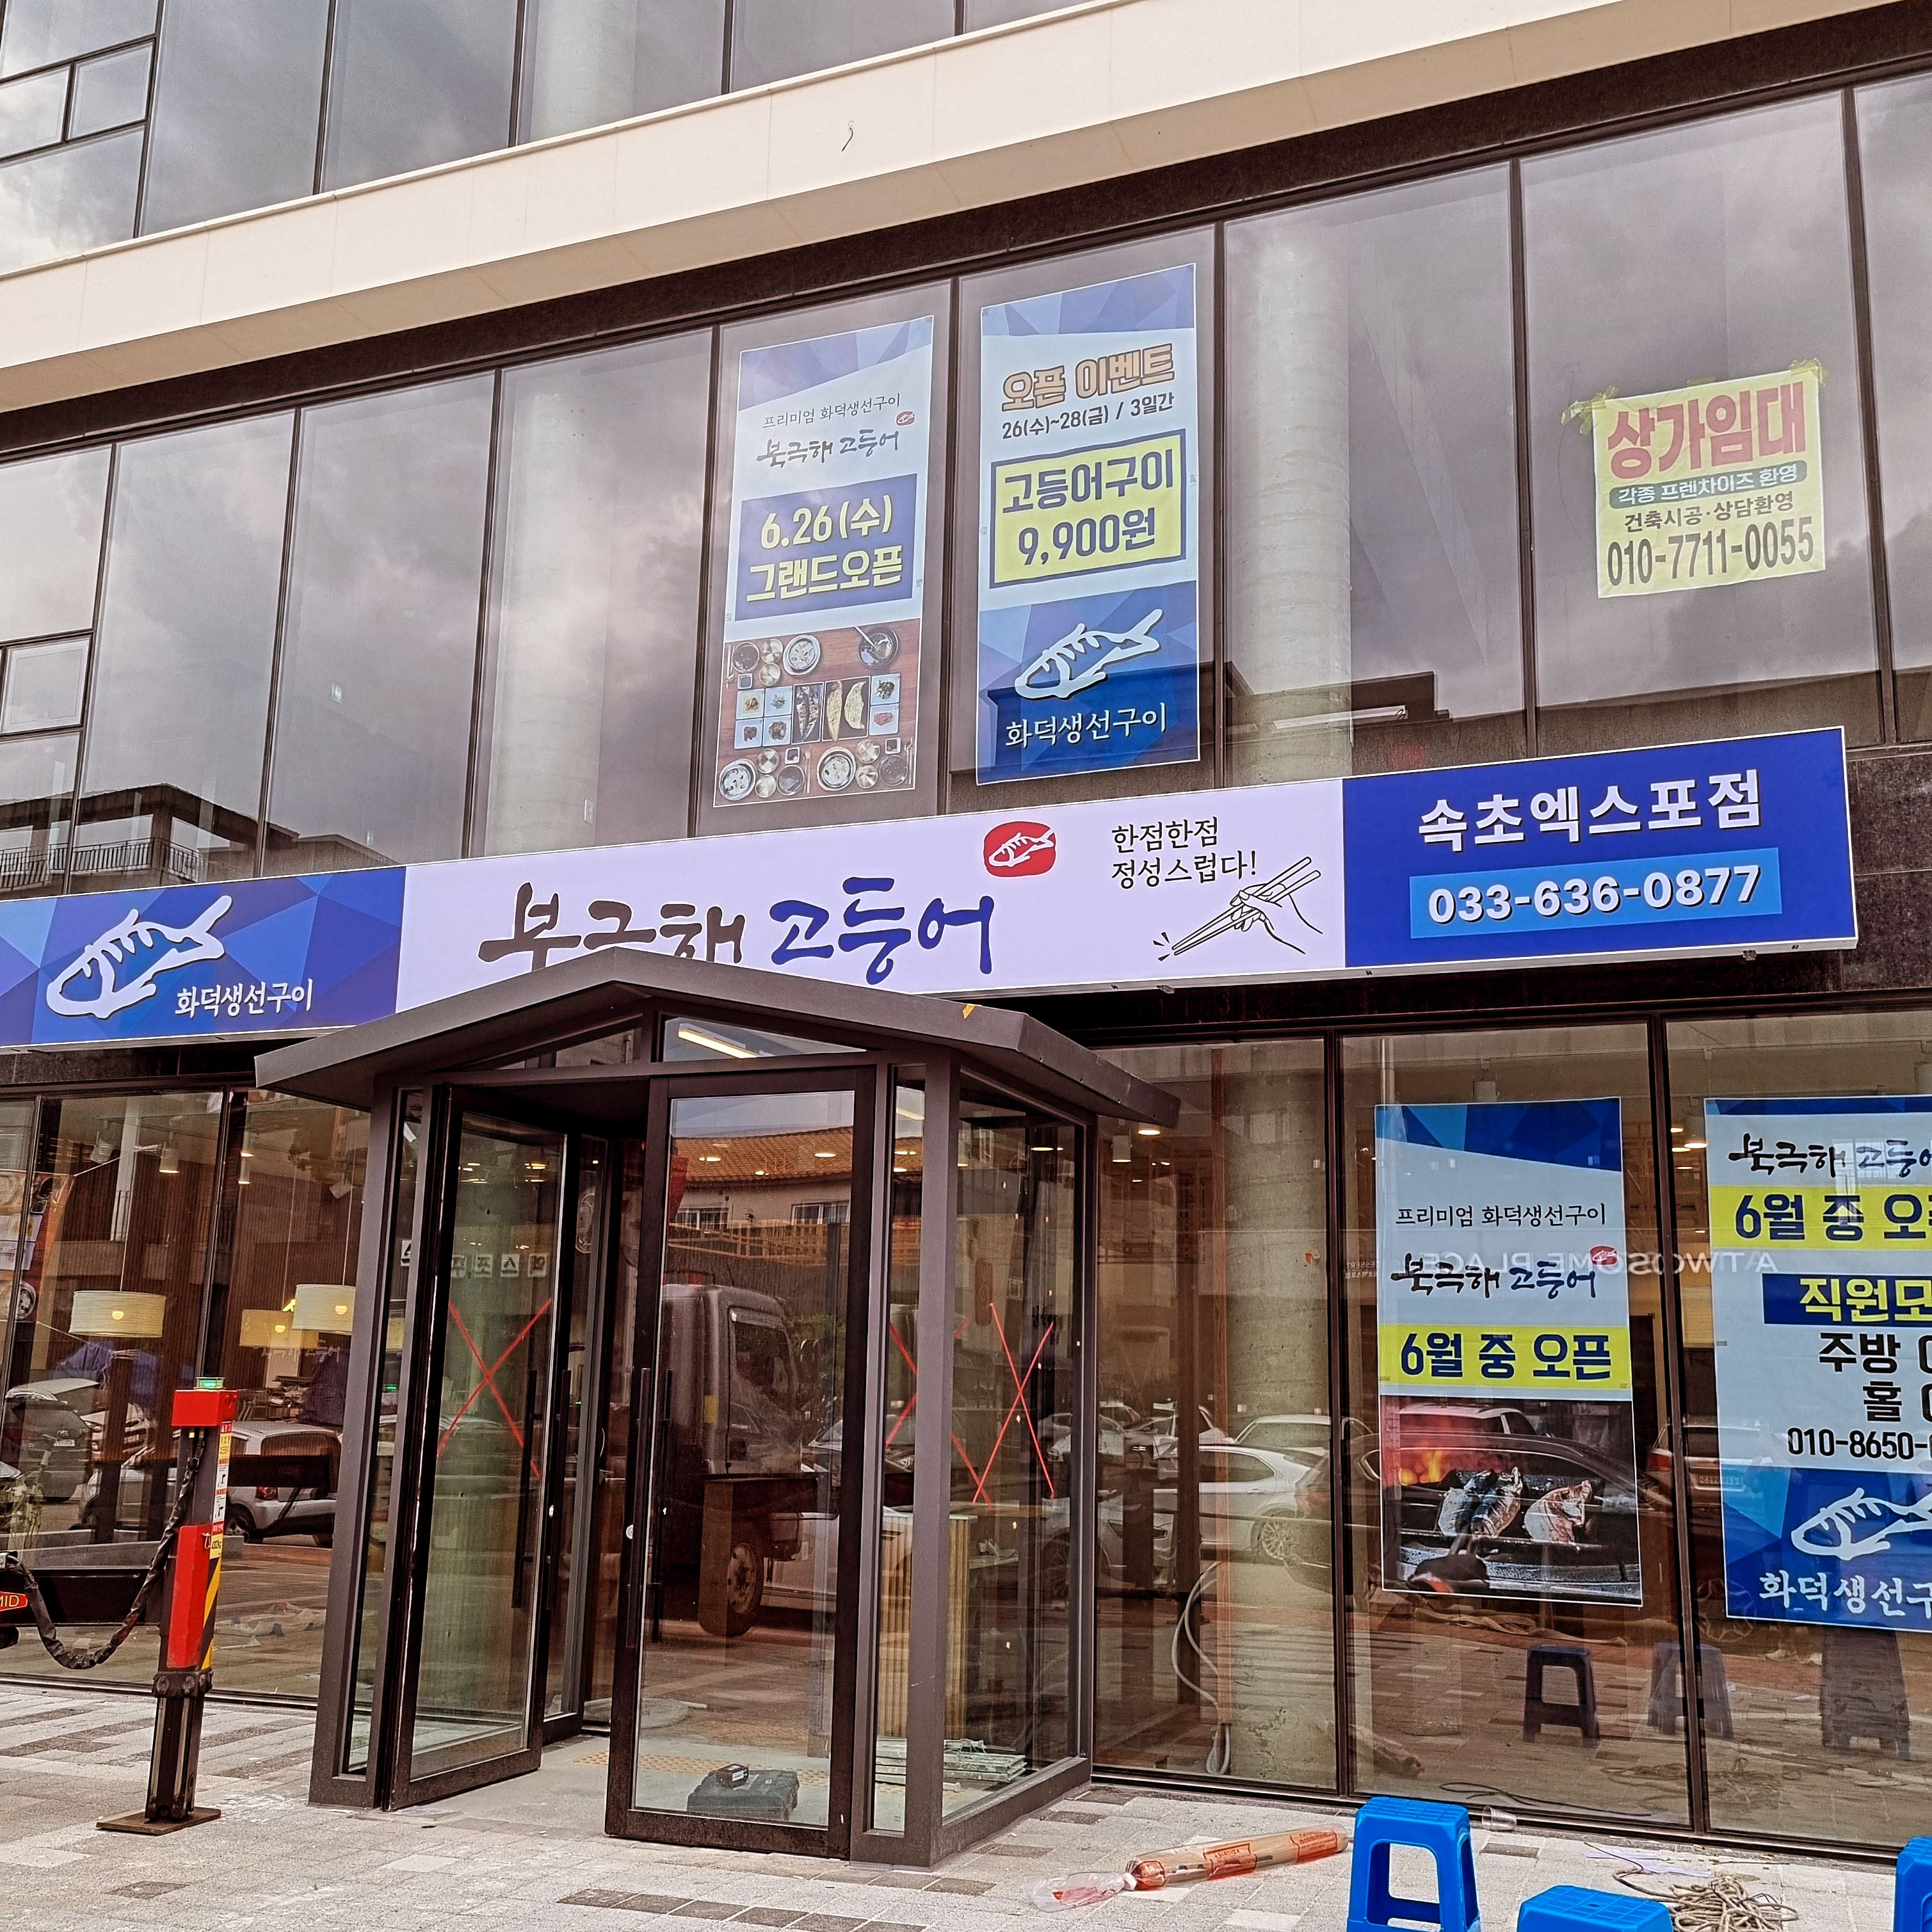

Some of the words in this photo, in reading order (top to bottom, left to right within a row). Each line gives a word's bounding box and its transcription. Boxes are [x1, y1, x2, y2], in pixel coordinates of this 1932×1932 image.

[1001, 364, 1067, 413] 오픈
[1077, 342, 1175, 399] 이벤트
[762, 408, 816, 429] 프리미엄
[820, 392, 901, 421] 화덕생선구이
[1002, 405, 1109, 440] 26(수)~28(금)
[1130, 392, 1175, 417] 3일간
[1607, 381, 1806, 479] 상가임대
[756, 435, 834, 469] 북극해
[840, 430, 899, 458] 고등어
[1002, 449, 1174, 515] 고등어구이
[1618, 485, 1655, 510] 각종
[1660, 471, 1755, 501] 프렌차이즈
[1759, 463, 1798, 487] 환영
[1018, 508, 1155, 567] 9,900원
[1607, 517, 1814, 587] 010-7711-0055
[746, 544, 903, 603] 그랜드오픈
[1004, 702, 1168, 748] 화덕생선구이
[1418, 769, 1761, 853] 속초엑스포점
[1112, 816, 1218, 854] 한점한점
[1112, 851, 1257, 889] 정성스럽다!
[1428, 864, 1761, 925] 033-636-0877
[769, 876, 995, 985] 고등어
[175, 978, 313, 1018] 화덕생선구이
[1728, 1132, 1846, 1177] 북극해
[1395, 1205, 1474, 1228] 프리미엄
[1481, 1203, 1606, 1228] 화덕생선구이
[1735, 1193, 1805, 1240] 6월
[1822, 1195, 1864, 1241] 중
[1884, 1195, 1932, 1239] 오
[1390, 1252, 1500, 1299] 북극해
[1509, 1260, 1596, 1299] 고등어
[1400, 1332, 1463, 1378] 6월
[1478, 1333, 1516, 1379] 중
[1533, 1334, 1611, 1380] 오픈
[1818, 1332, 1901, 1374] 주방
[1863, 1381, 1902, 1422] 홀
[1788, 1428, 1932, 1460] 010-8650-
